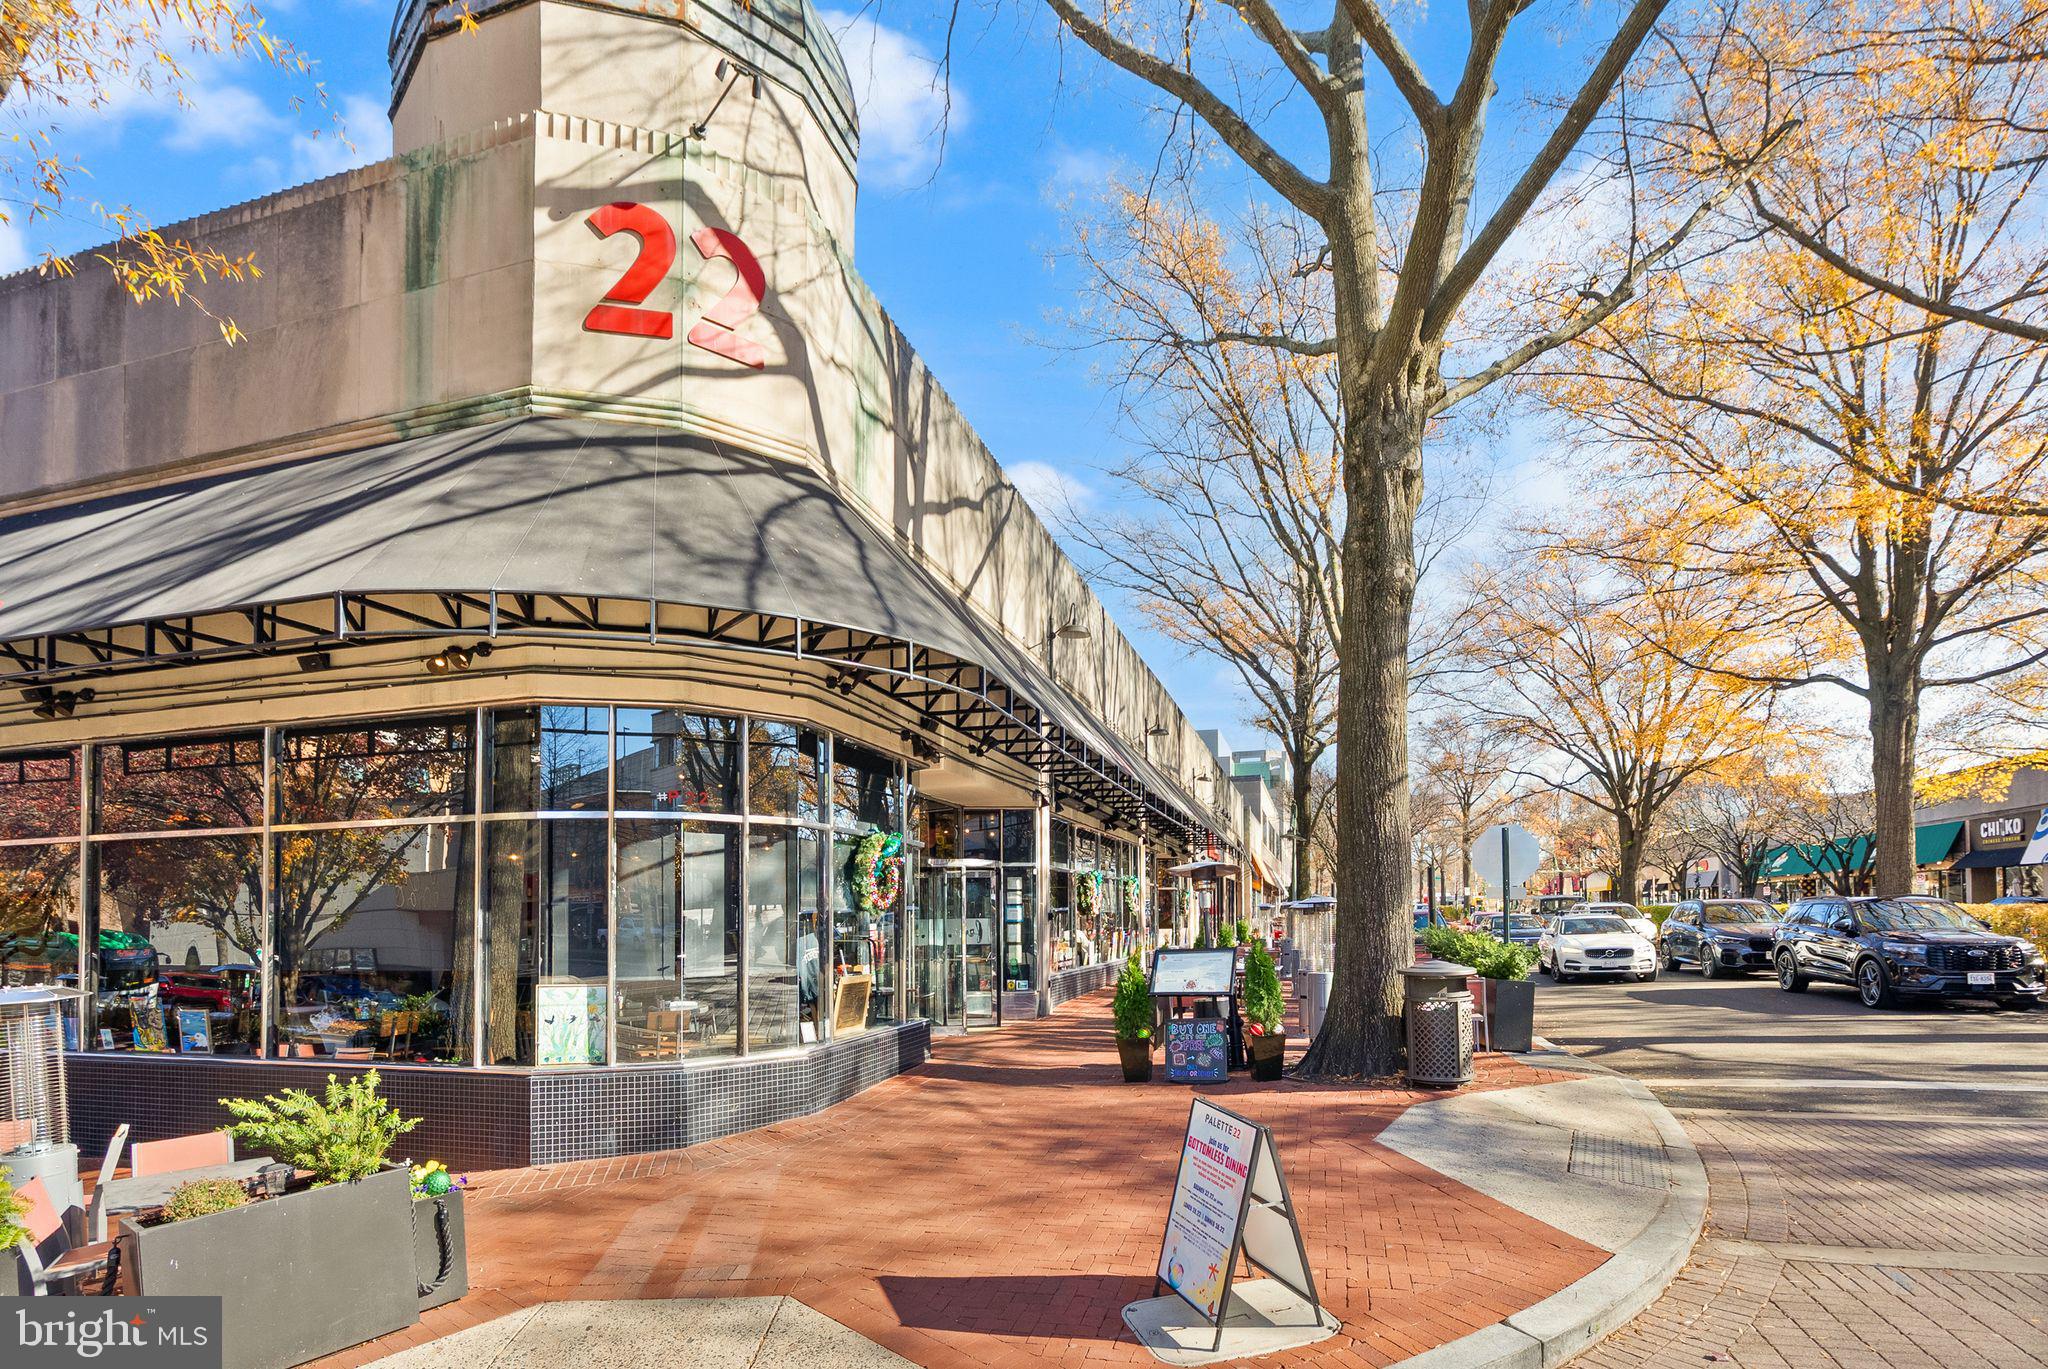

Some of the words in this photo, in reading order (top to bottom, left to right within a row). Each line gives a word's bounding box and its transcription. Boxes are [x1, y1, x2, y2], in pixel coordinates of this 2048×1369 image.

[583, 201, 766, 369] 22
[1171, 1023, 1194, 1034] BUY
[1197, 1023, 1216, 1034] ONE
[1205, 1114, 1233, 1135] PALETTE
[1187, 1135, 1225, 1165] BOTTOMLESS
[1225, 1155, 1248, 1178] DINING
